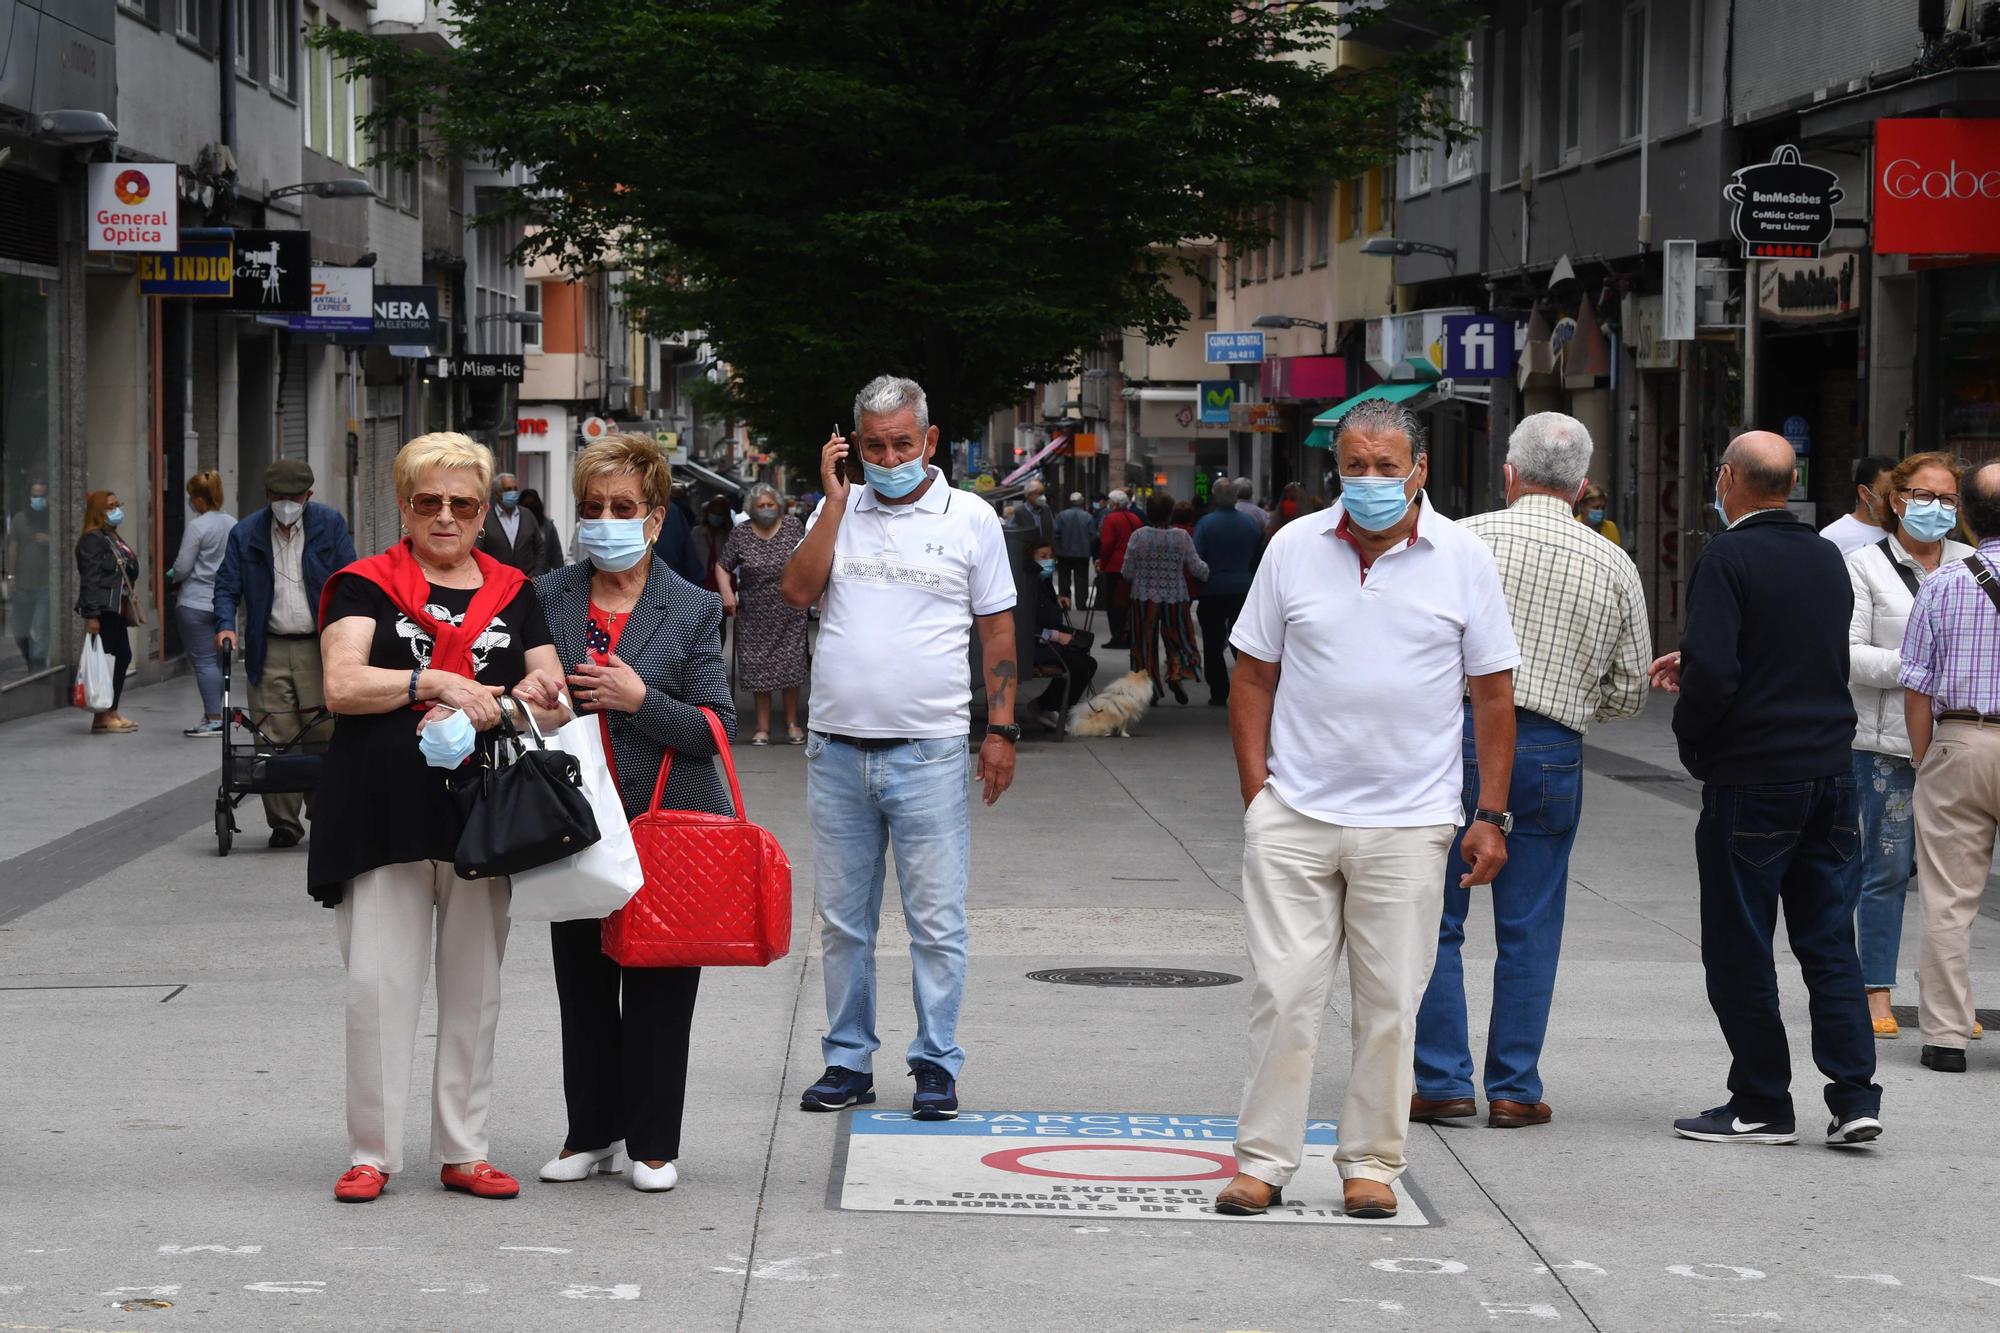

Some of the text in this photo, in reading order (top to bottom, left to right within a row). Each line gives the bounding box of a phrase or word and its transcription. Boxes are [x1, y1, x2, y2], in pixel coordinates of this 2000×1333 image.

[1752, 190, 1821, 205] BenMeSabes
[97, 210, 168, 226] General
[1760, 221, 1811, 232] Para Llevar
[103, 227, 161, 245] Optica
[141, 256, 232, 282] EL INDIO
[1236, 334, 1261, 346] DENTAL
[949, 1113, 1338, 1130] BARCELOA
[1052, 1185, 1203, 1196] EXCEPTO
[893, 1198, 1118, 1211] LABORABLES
[1140, 1204, 1182, 1213] DE
[952, 1191, 1307, 1207] CARGA Y DESCA
